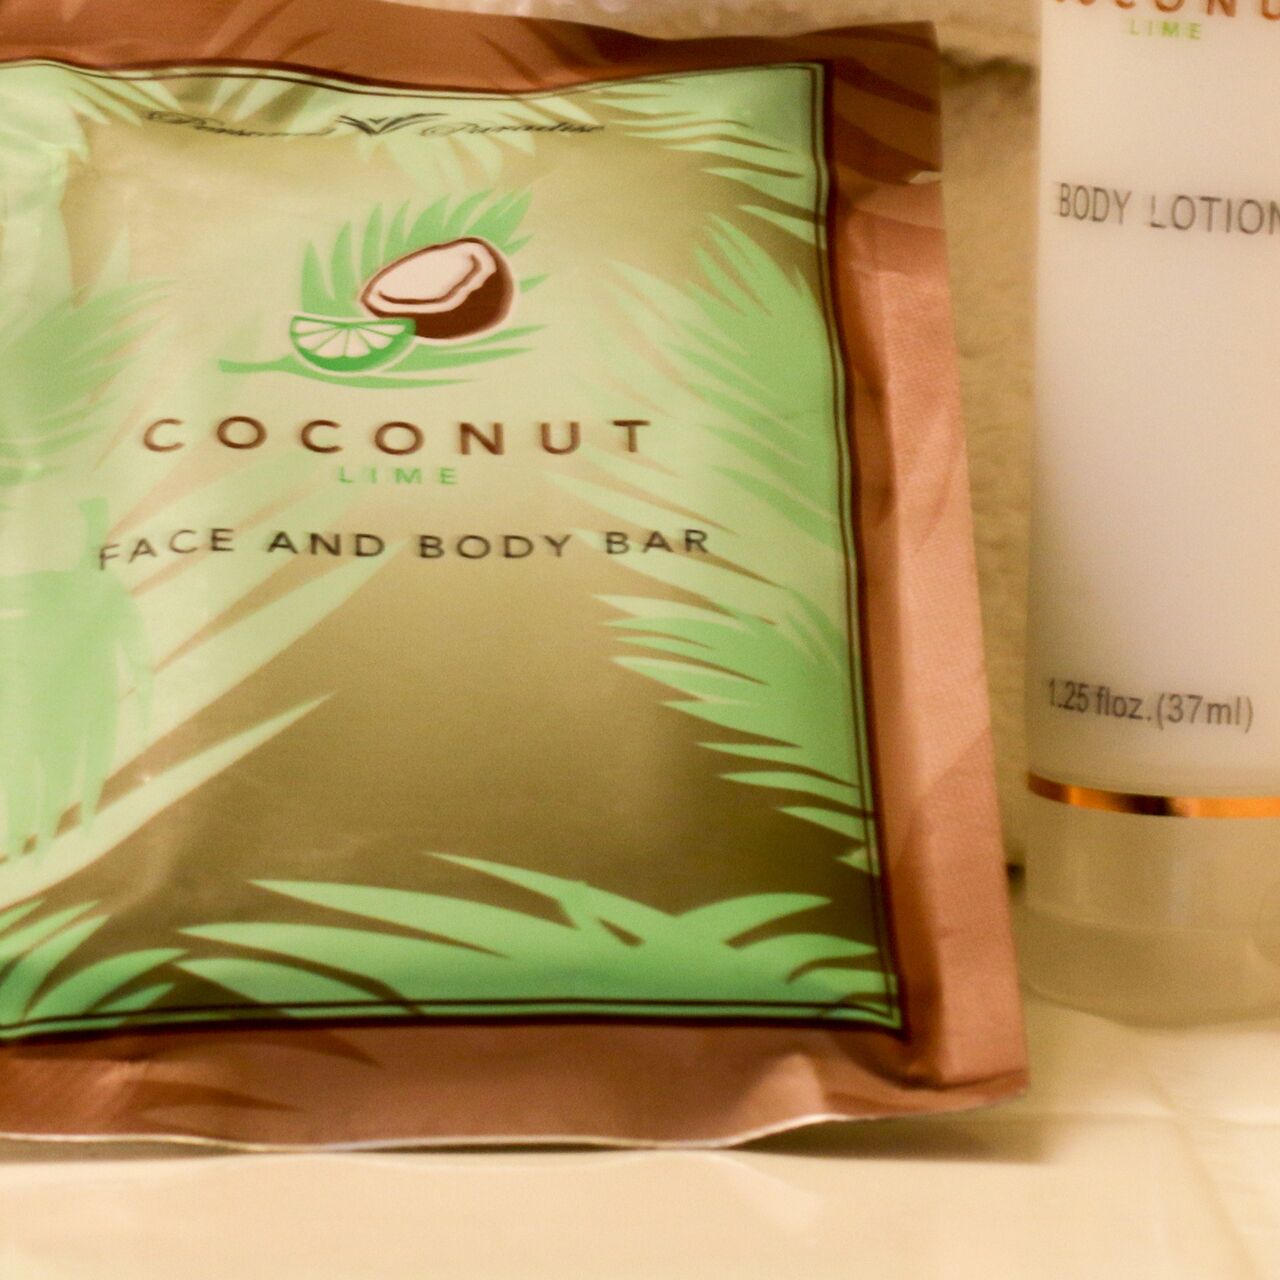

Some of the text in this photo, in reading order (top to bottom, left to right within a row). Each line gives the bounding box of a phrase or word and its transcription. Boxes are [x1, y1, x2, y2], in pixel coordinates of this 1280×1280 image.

[1129, 19, 1202, 40] LIME
[1058, 181, 1132, 225] BODY
[142, 415, 651, 456] COCONUT
[337, 466, 459, 486] LIME
[98, 526, 710, 571] FACE AND BODY BAR
[1048, 676, 1090, 713] 1.25
